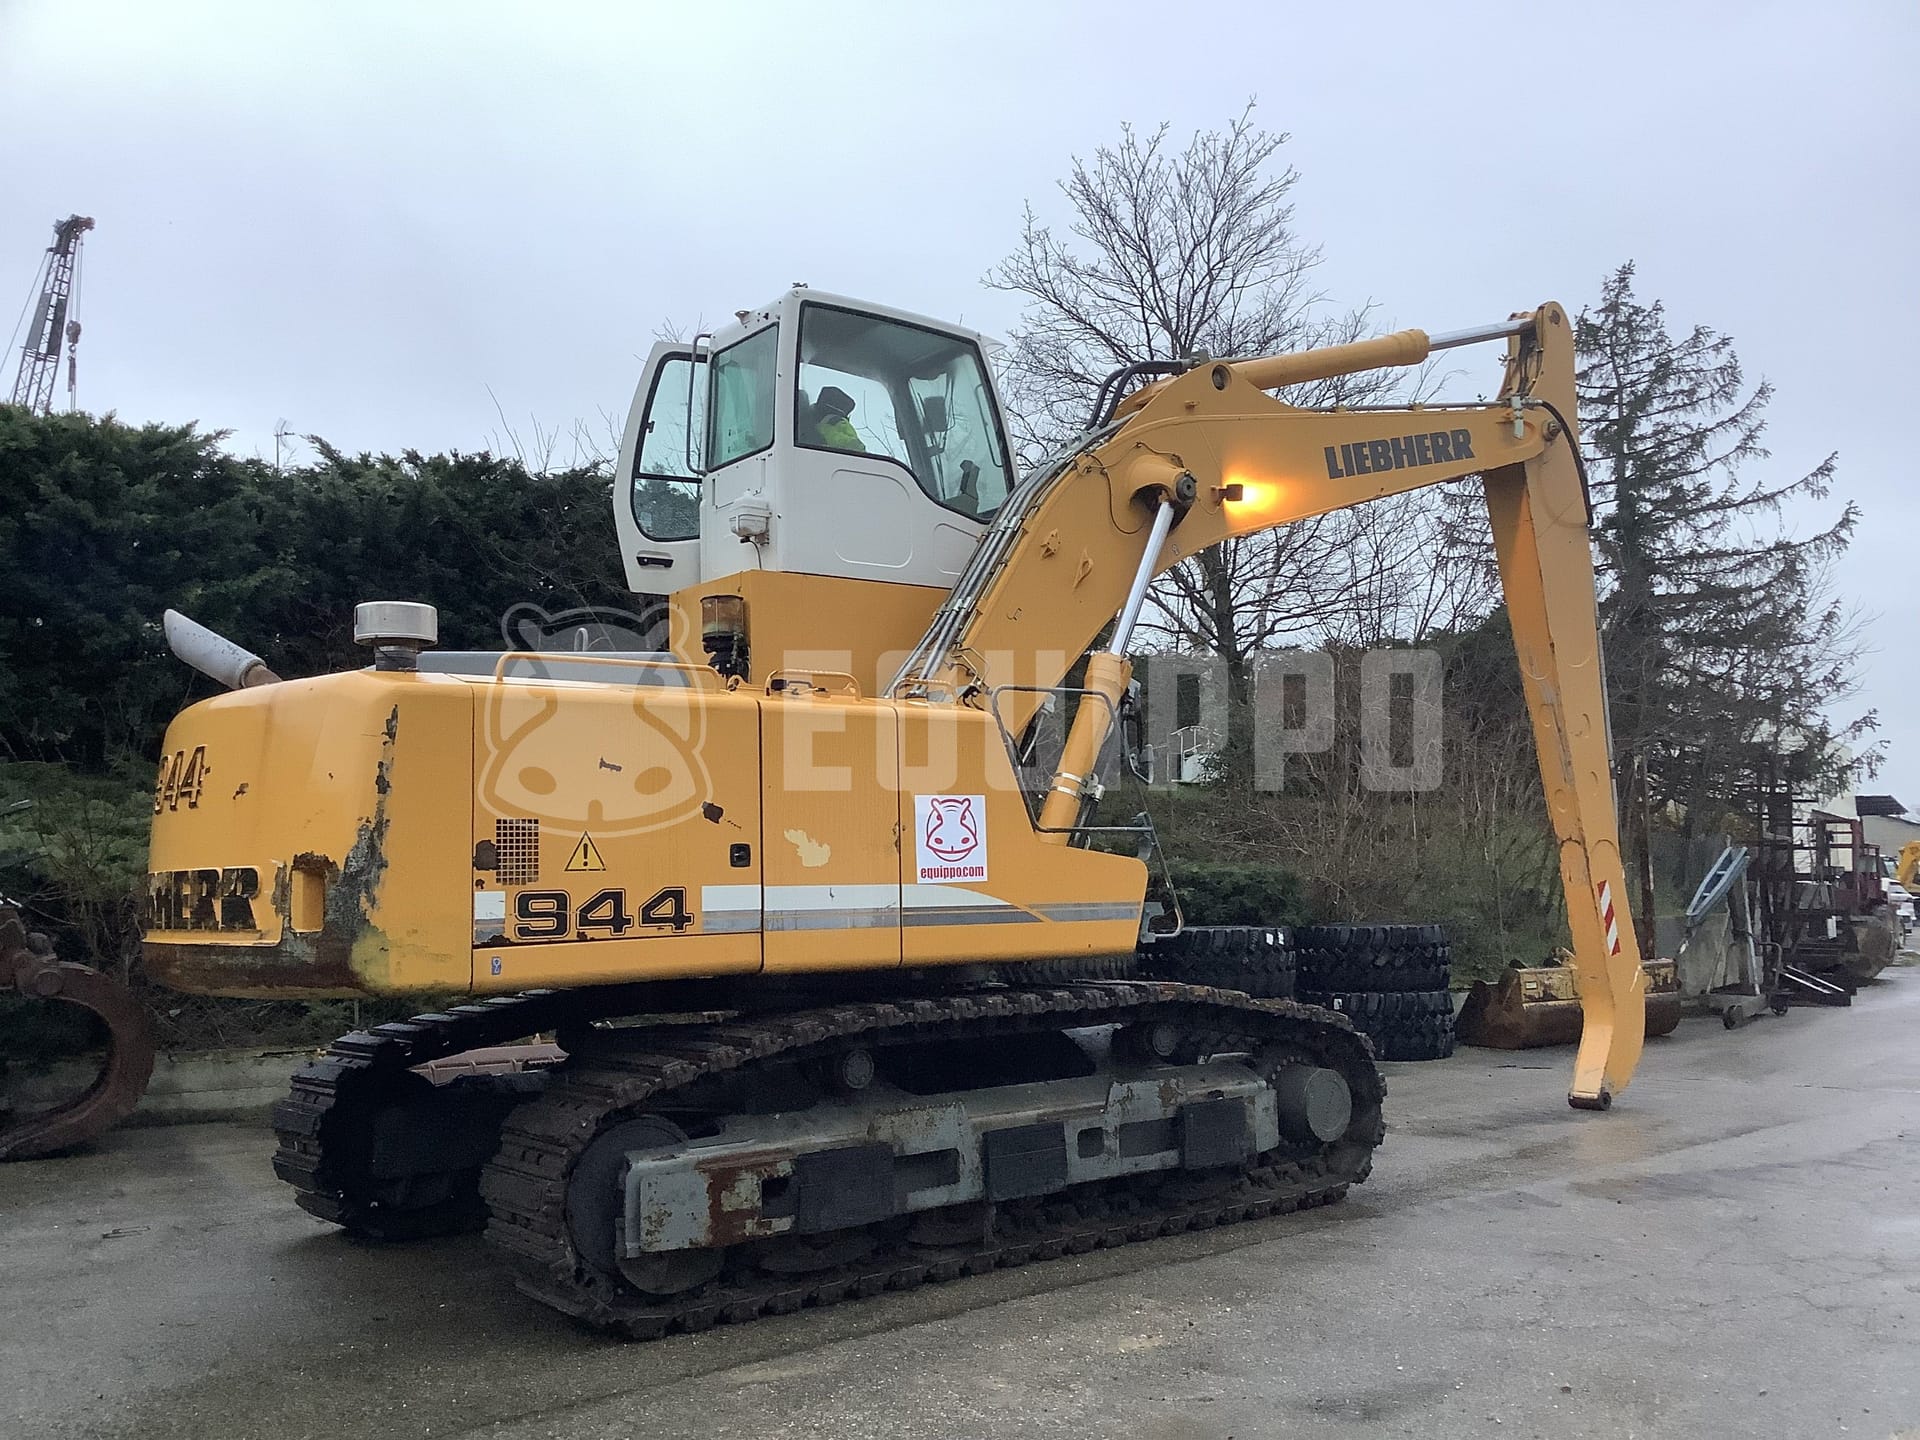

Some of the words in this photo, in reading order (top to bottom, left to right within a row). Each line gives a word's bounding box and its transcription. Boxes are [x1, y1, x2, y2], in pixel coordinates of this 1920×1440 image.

[1324, 428, 1476, 480] LIEBHERR
[920, 865, 984, 880] equippo.com
[514, 887, 695, 939] 944
